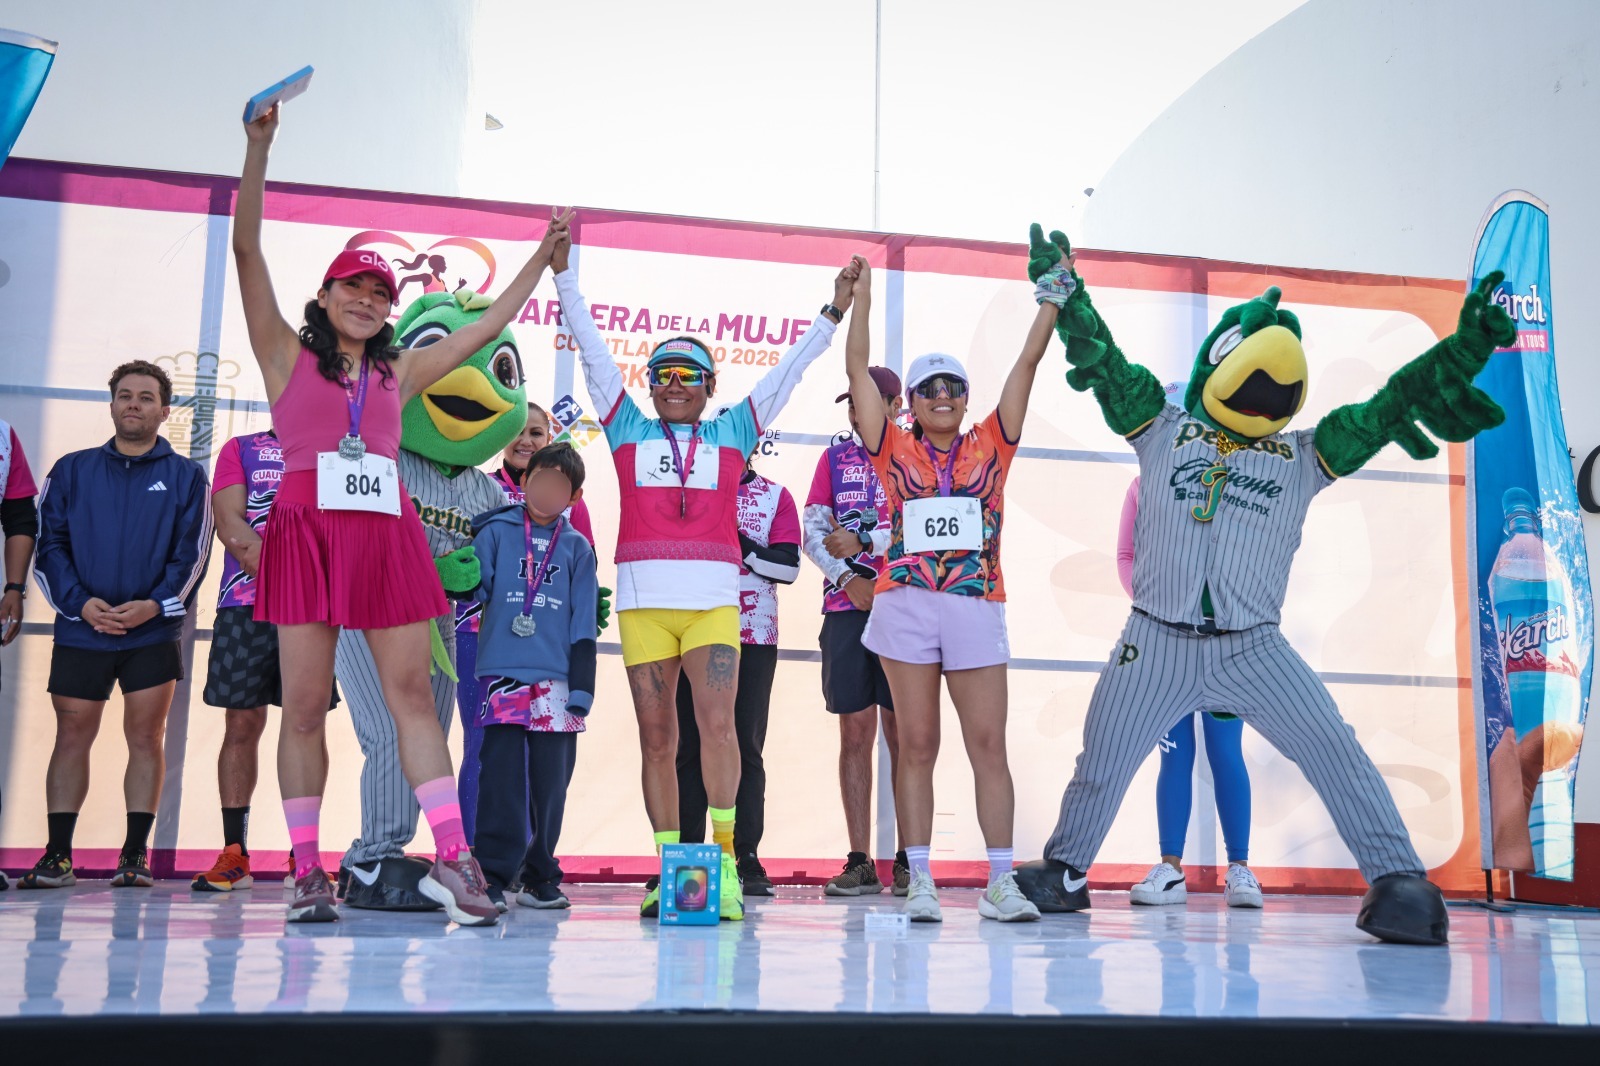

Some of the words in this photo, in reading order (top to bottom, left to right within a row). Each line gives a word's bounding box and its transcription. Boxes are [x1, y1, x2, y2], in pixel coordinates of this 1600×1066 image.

[360, 252, 389, 273] alo
[656, 314, 682, 331] DE
[685, 317, 710, 333] LA
[715, 312, 812, 346] MUJE
[730, 348, 780, 366] 2026
[765, 428, 781, 440] DE
[346, 474, 381, 497] 804
[925, 517, 960, 537] 626
